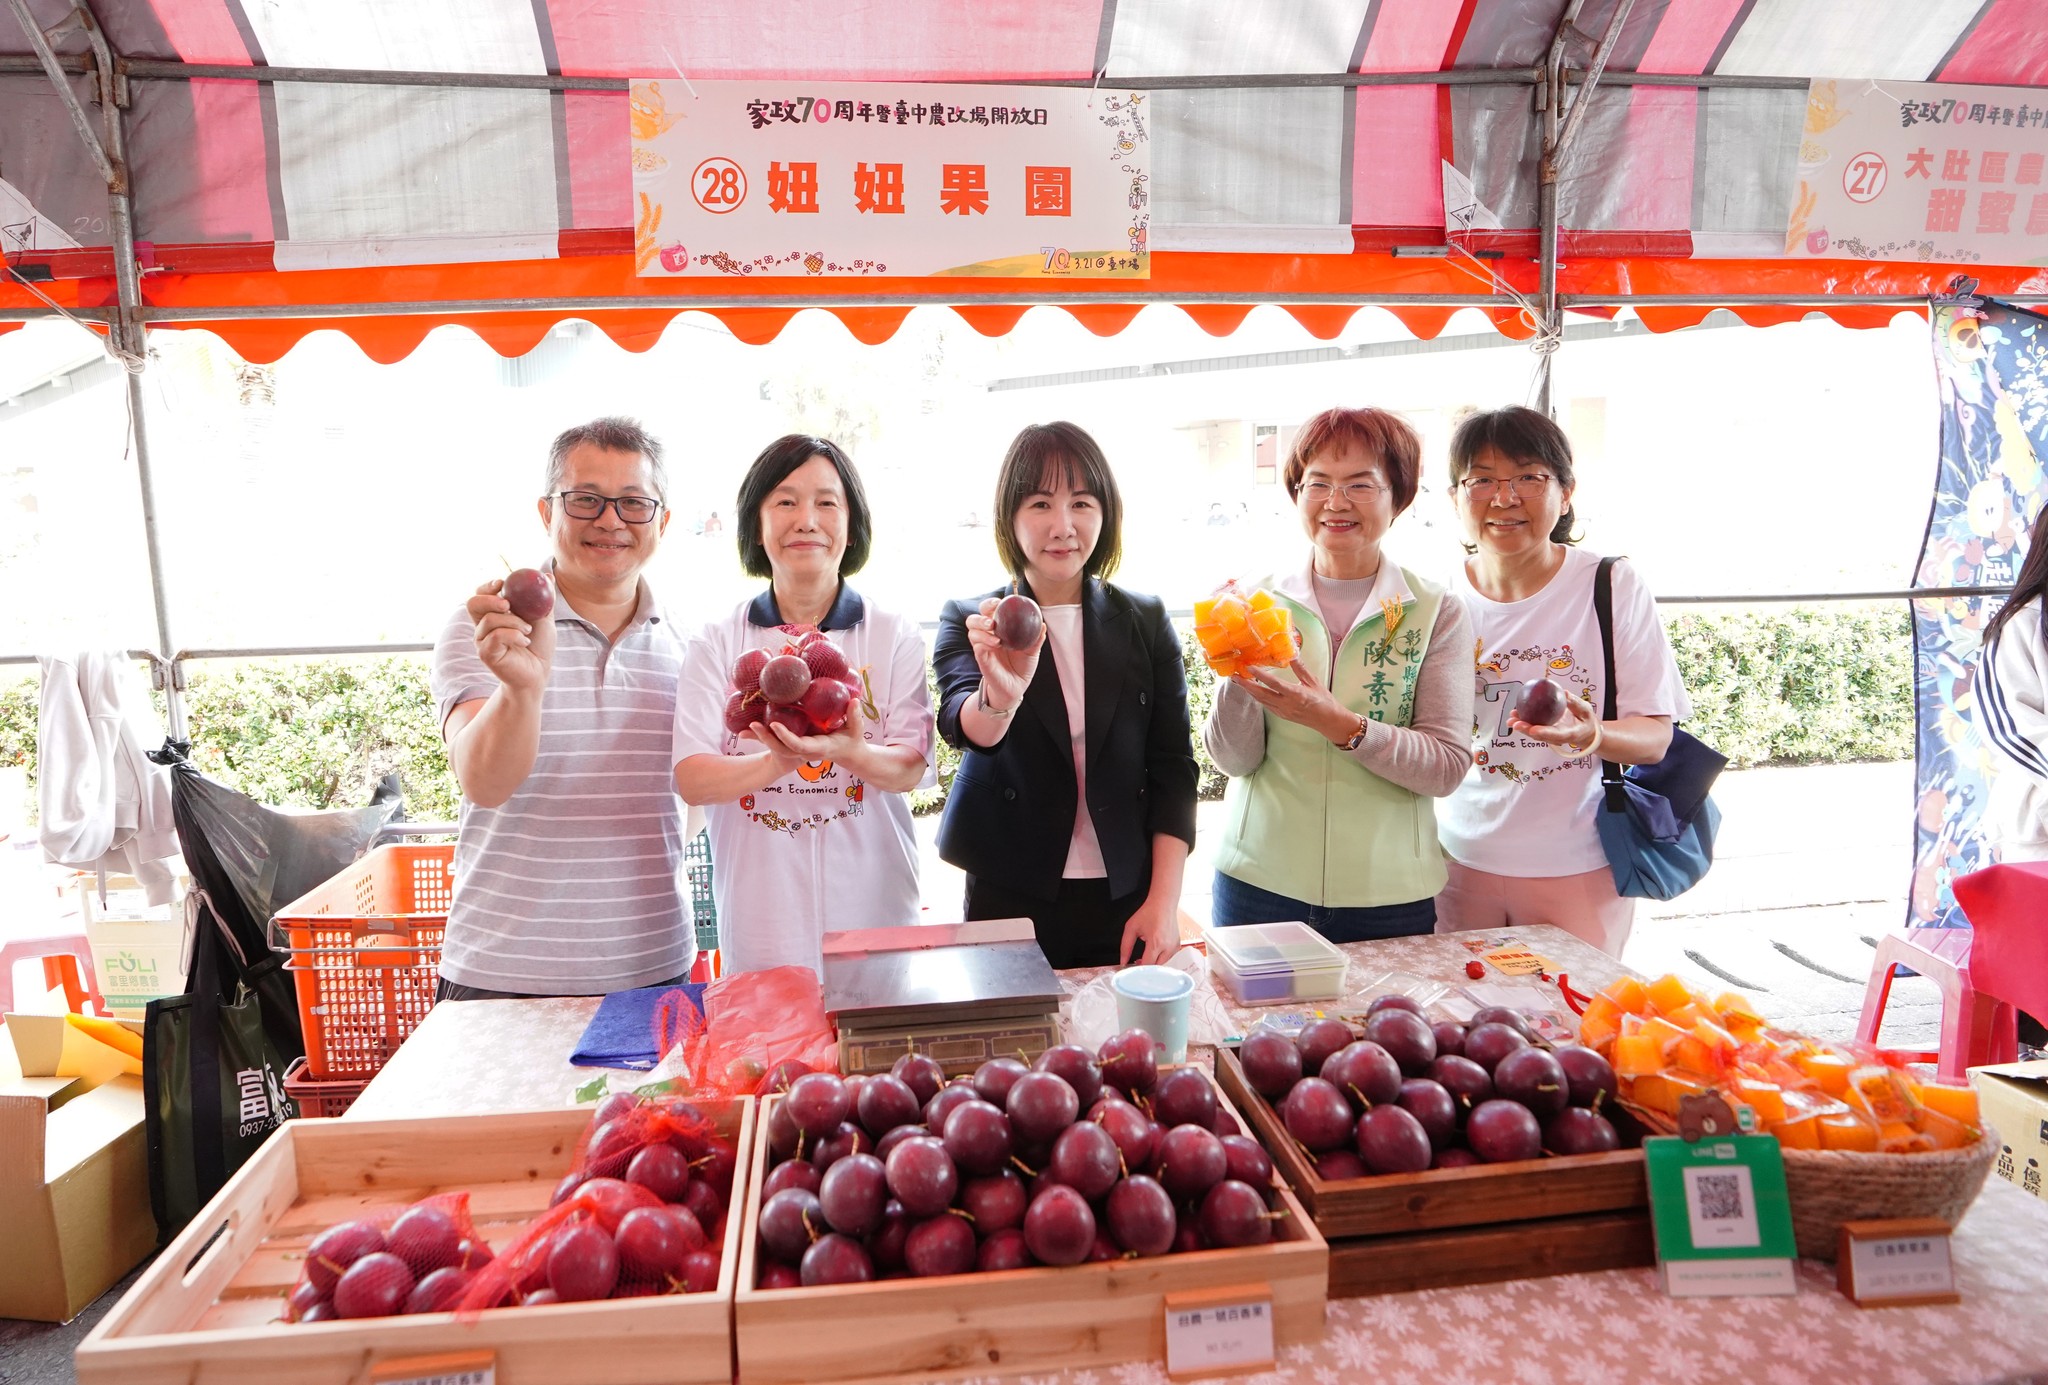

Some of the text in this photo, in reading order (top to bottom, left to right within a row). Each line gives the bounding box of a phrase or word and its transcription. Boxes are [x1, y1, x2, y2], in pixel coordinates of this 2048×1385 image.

[746, 97, 1047, 129] 家政70周年暨臺中農改場開放日
[699, 161, 1071, 216] 28 妞妞果園
[1847, 159, 1884, 198] 27
[1394, 629, 1421, 727] 彰化縣長候
[1491, 739, 1549, 748] Home Econo
[758, 784, 838, 795] ome Economics
